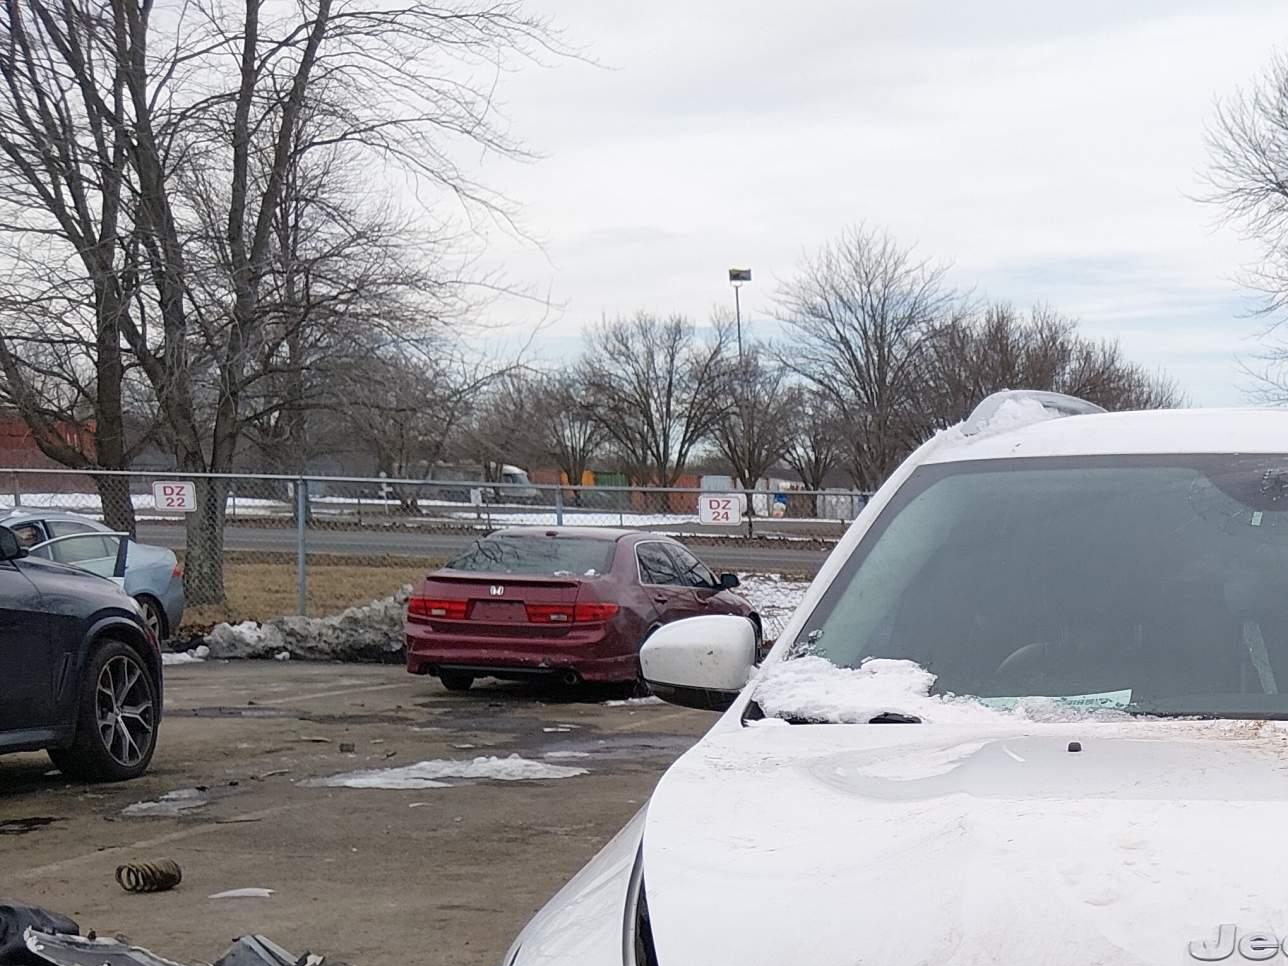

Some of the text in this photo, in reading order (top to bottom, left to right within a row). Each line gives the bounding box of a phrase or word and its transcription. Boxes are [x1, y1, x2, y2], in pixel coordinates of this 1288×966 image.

[163, 485, 185, 496] DZ
[166, 497, 185, 507] 22
[708, 499, 731, 510] DZ
[712, 511, 730, 521] 24
